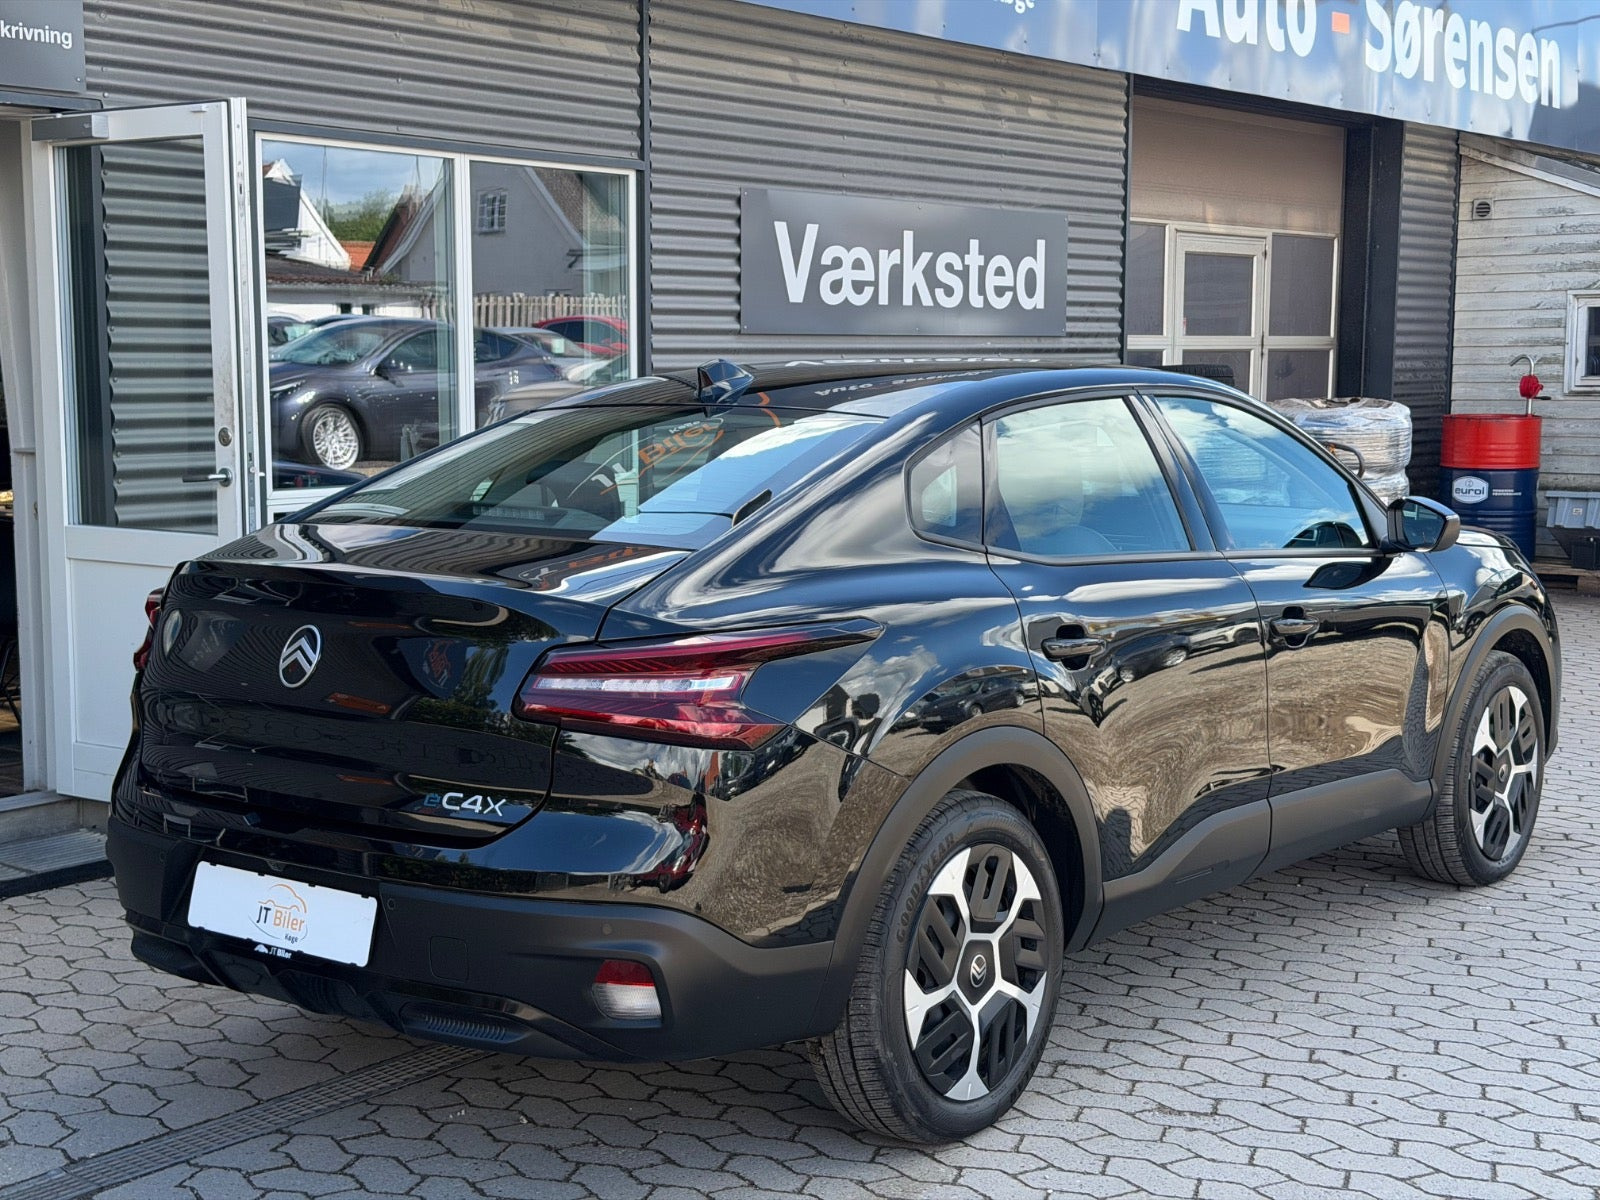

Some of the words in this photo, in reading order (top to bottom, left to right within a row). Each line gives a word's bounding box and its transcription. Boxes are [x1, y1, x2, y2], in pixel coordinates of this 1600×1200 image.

[1364, 0, 1561, 109] Sørensen
[774, 221, 1046, 310] Værksted
[1454, 486, 1485, 496] eurol
[256, 905, 271, 924] JT
[273, 909, 305, 932] Biler
[276, 948, 292, 959] Biler
